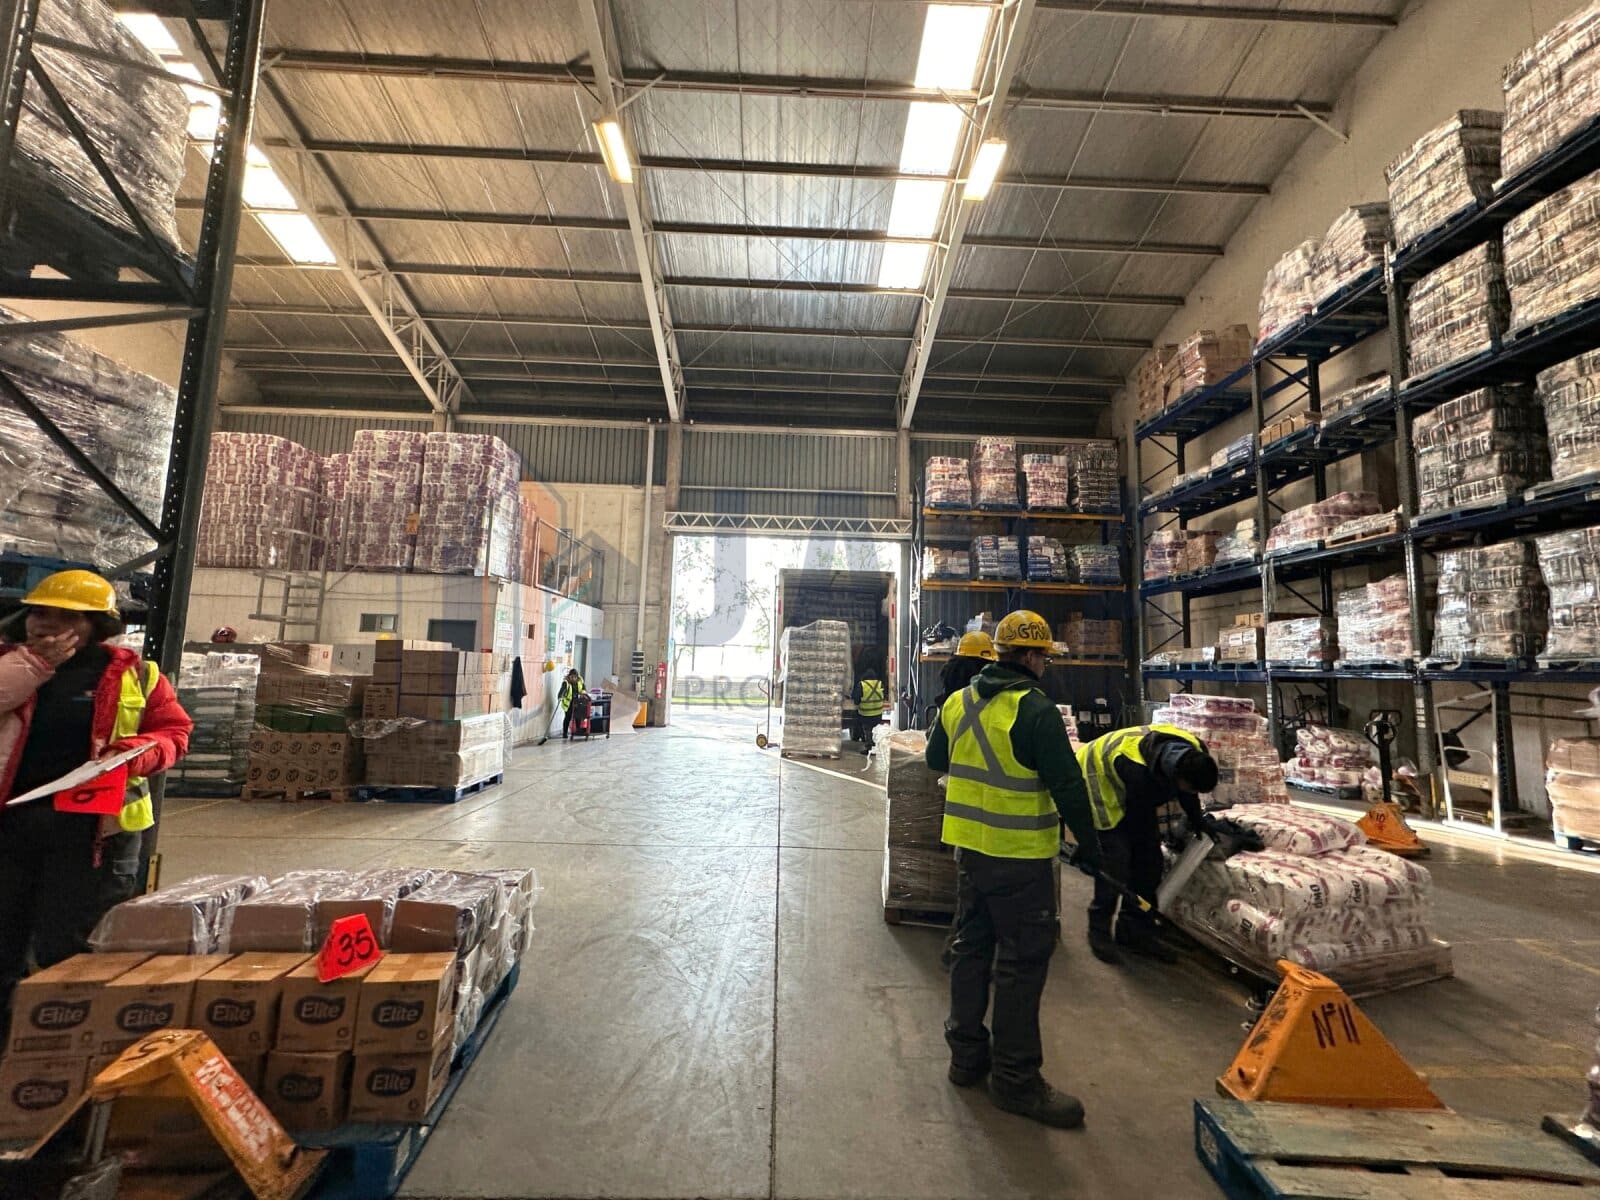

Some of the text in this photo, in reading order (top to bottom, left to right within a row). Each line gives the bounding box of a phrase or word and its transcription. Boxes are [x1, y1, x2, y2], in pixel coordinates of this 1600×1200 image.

[338, 928, 374, 966] 35
[37, 1005, 86, 1025] Elite
[123, 1007, 169, 1028] Elite
[212, 1003, 252, 1022] Elite
[300, 1000, 341, 1019] Elite
[377, 1005, 420, 1023] Elite
[371, 1072, 411, 1092] Elite
